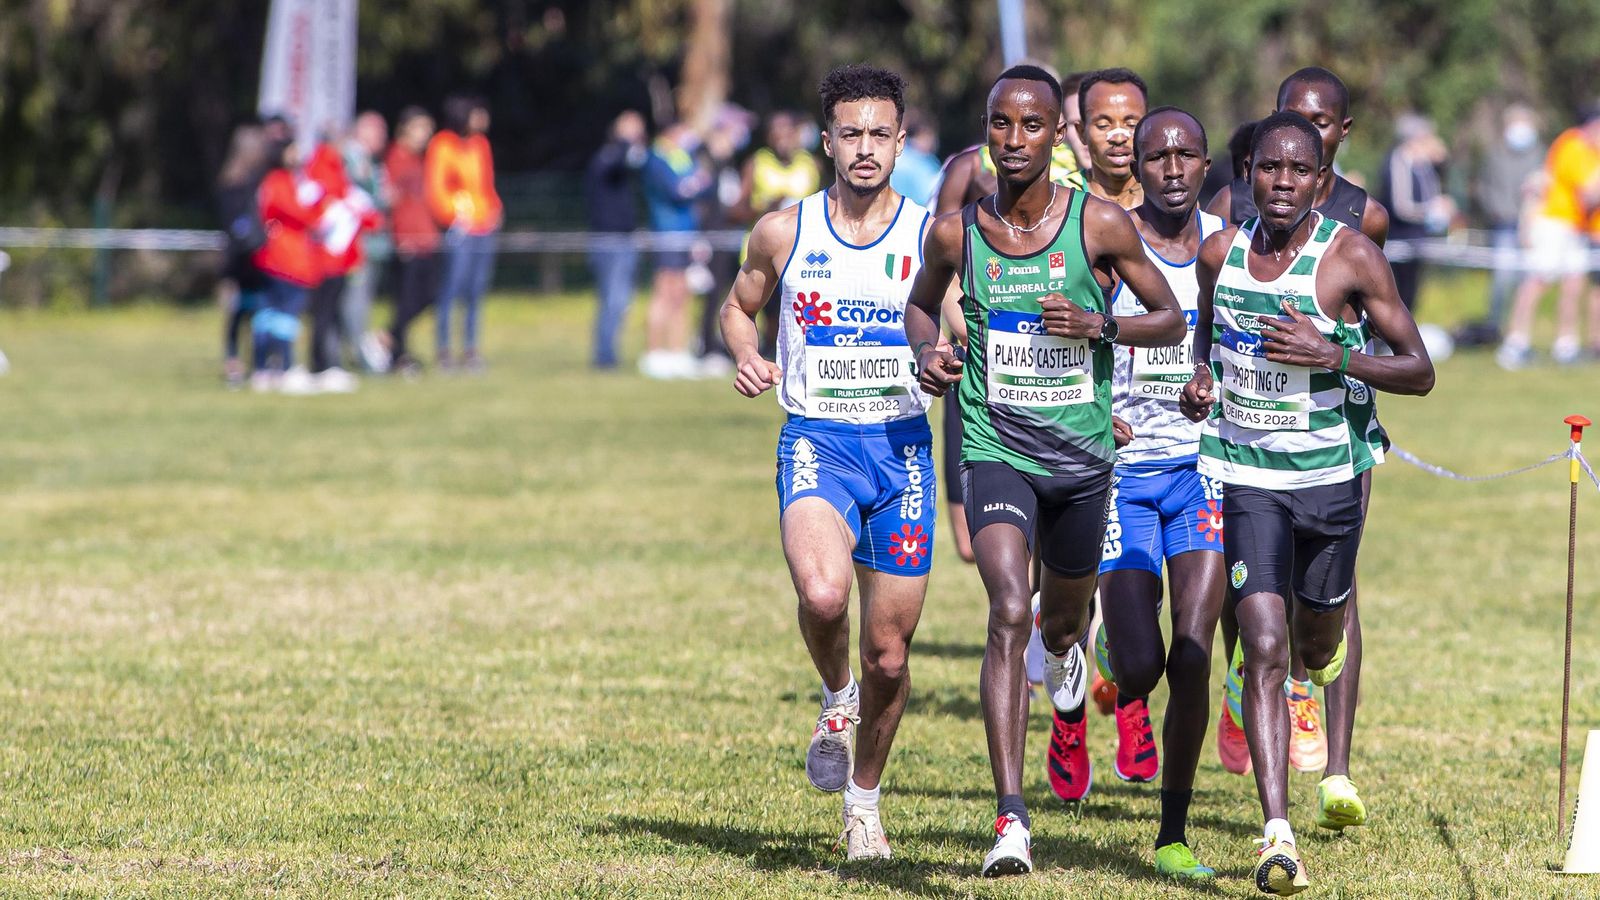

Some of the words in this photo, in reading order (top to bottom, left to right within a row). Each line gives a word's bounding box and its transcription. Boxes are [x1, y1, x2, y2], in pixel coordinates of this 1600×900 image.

[801, 269, 831, 278] errea
[988, 282, 1047, 294] VILLARREAL
[837, 299, 876, 307] ATLETICA
[837, 307, 904, 323] cason
[1017, 320, 1041, 335] OZ
[834, 333, 858, 347] OZ
[1146, 345, 1184, 366] CASONE
[1236, 341, 1255, 356] OZ
[995, 344, 1034, 368] PLAYAS
[1036, 344, 1086, 369] CASTELLO
[818, 359, 856, 380] CASONE
[860, 358, 899, 379] NOCETO
[1036, 378, 1063, 386] CLEAN
[1275, 372, 1288, 393] CP
[838, 389, 854, 398] RUN
[855, 388, 880, 397] CLEAN
[999, 388, 1047, 402] OEIRAS
[1051, 388, 1082, 402] 2022
[1142, 384, 1183, 397] OEIRA
[818, 401, 866, 413] OEIRAS
[869, 399, 900, 412] 2022
[1237, 397, 1250, 406] RUN
[1250, 400, 1276, 409] CLEAN
[1226, 403, 1261, 424] OEIRAS
[1264, 414, 1297, 425] 2022
